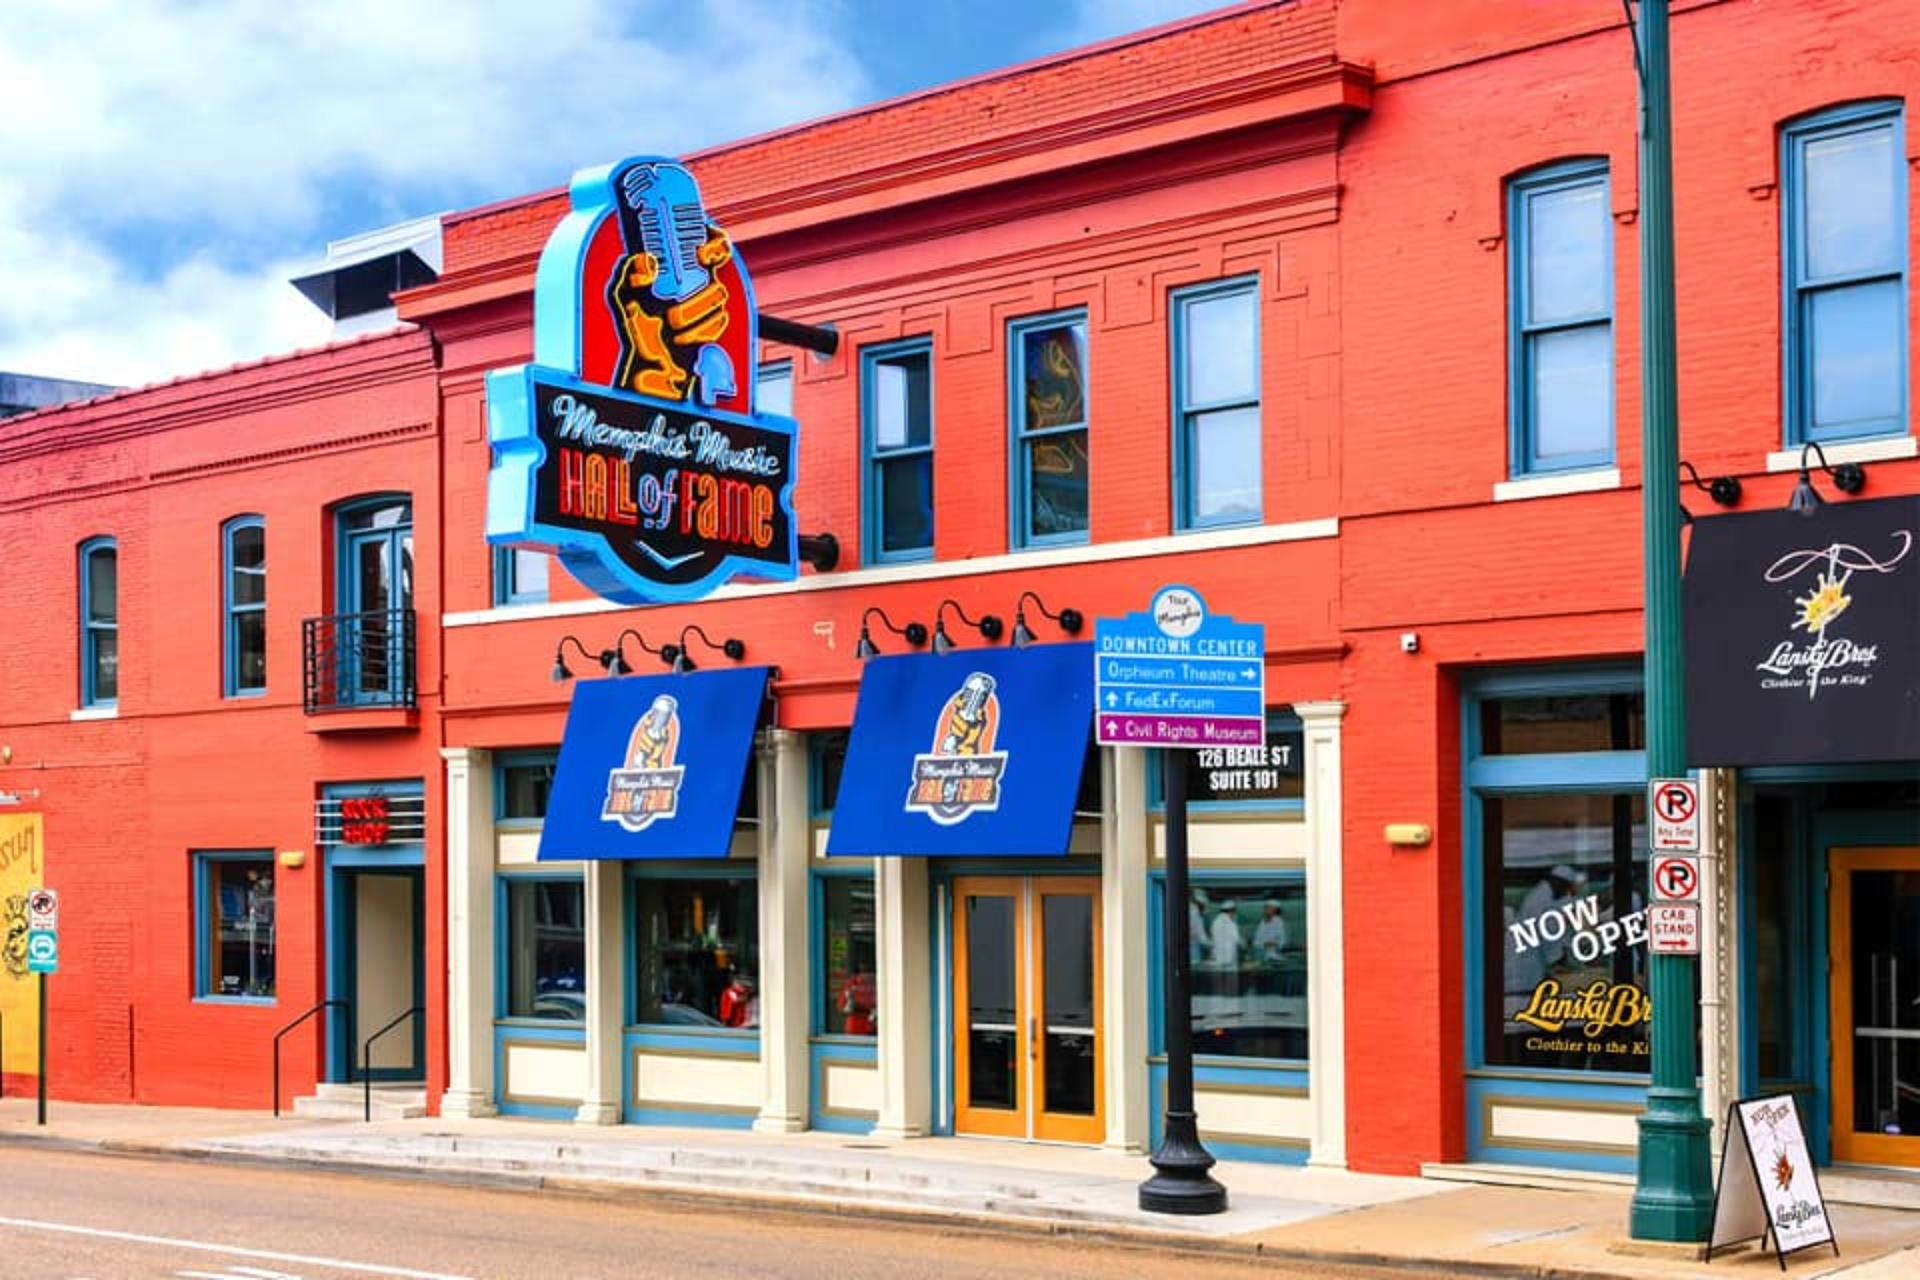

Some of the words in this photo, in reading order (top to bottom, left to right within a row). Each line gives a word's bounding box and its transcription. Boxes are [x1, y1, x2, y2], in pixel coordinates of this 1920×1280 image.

[552, 394, 692, 463] Memphis
[689, 421, 781, 475] Music
[559, 447, 640, 527] HALL
[638, 468, 680, 530] of
[1102, 636, 1191, 654] DOWNTOWN
[1197, 639, 1257, 656] CENTER
[1108, 662, 1175, 681] Orpheum
[1182, 663, 1237, 682] Theatre
[1821, 675, 1837, 686] the
[1125, 690, 1215, 709] FedExForum
[1125, 721, 1153, 738] Civil
[1157, 721, 1199, 740] Rights
[1204, 722, 1258, 741] Museum
[1197, 749, 1224, 768] 126
[1225, 747, 1268, 767] BEALE
[1271, 745, 1291, 766] ST
[1209, 770, 1251, 790] SUITE
[1252, 770, 1279, 790] 101
[1509, 895, 1601, 953] NOW
[1661, 910, 1686, 921] CAB
[1571, 908, 1650, 962] OPE
[1654, 923, 1695, 936] STAND
[1526, 1036, 1584, 1052] Clothier
[1587, 1038, 1601, 1053] to
[1605, 1038, 1627, 1054] the
